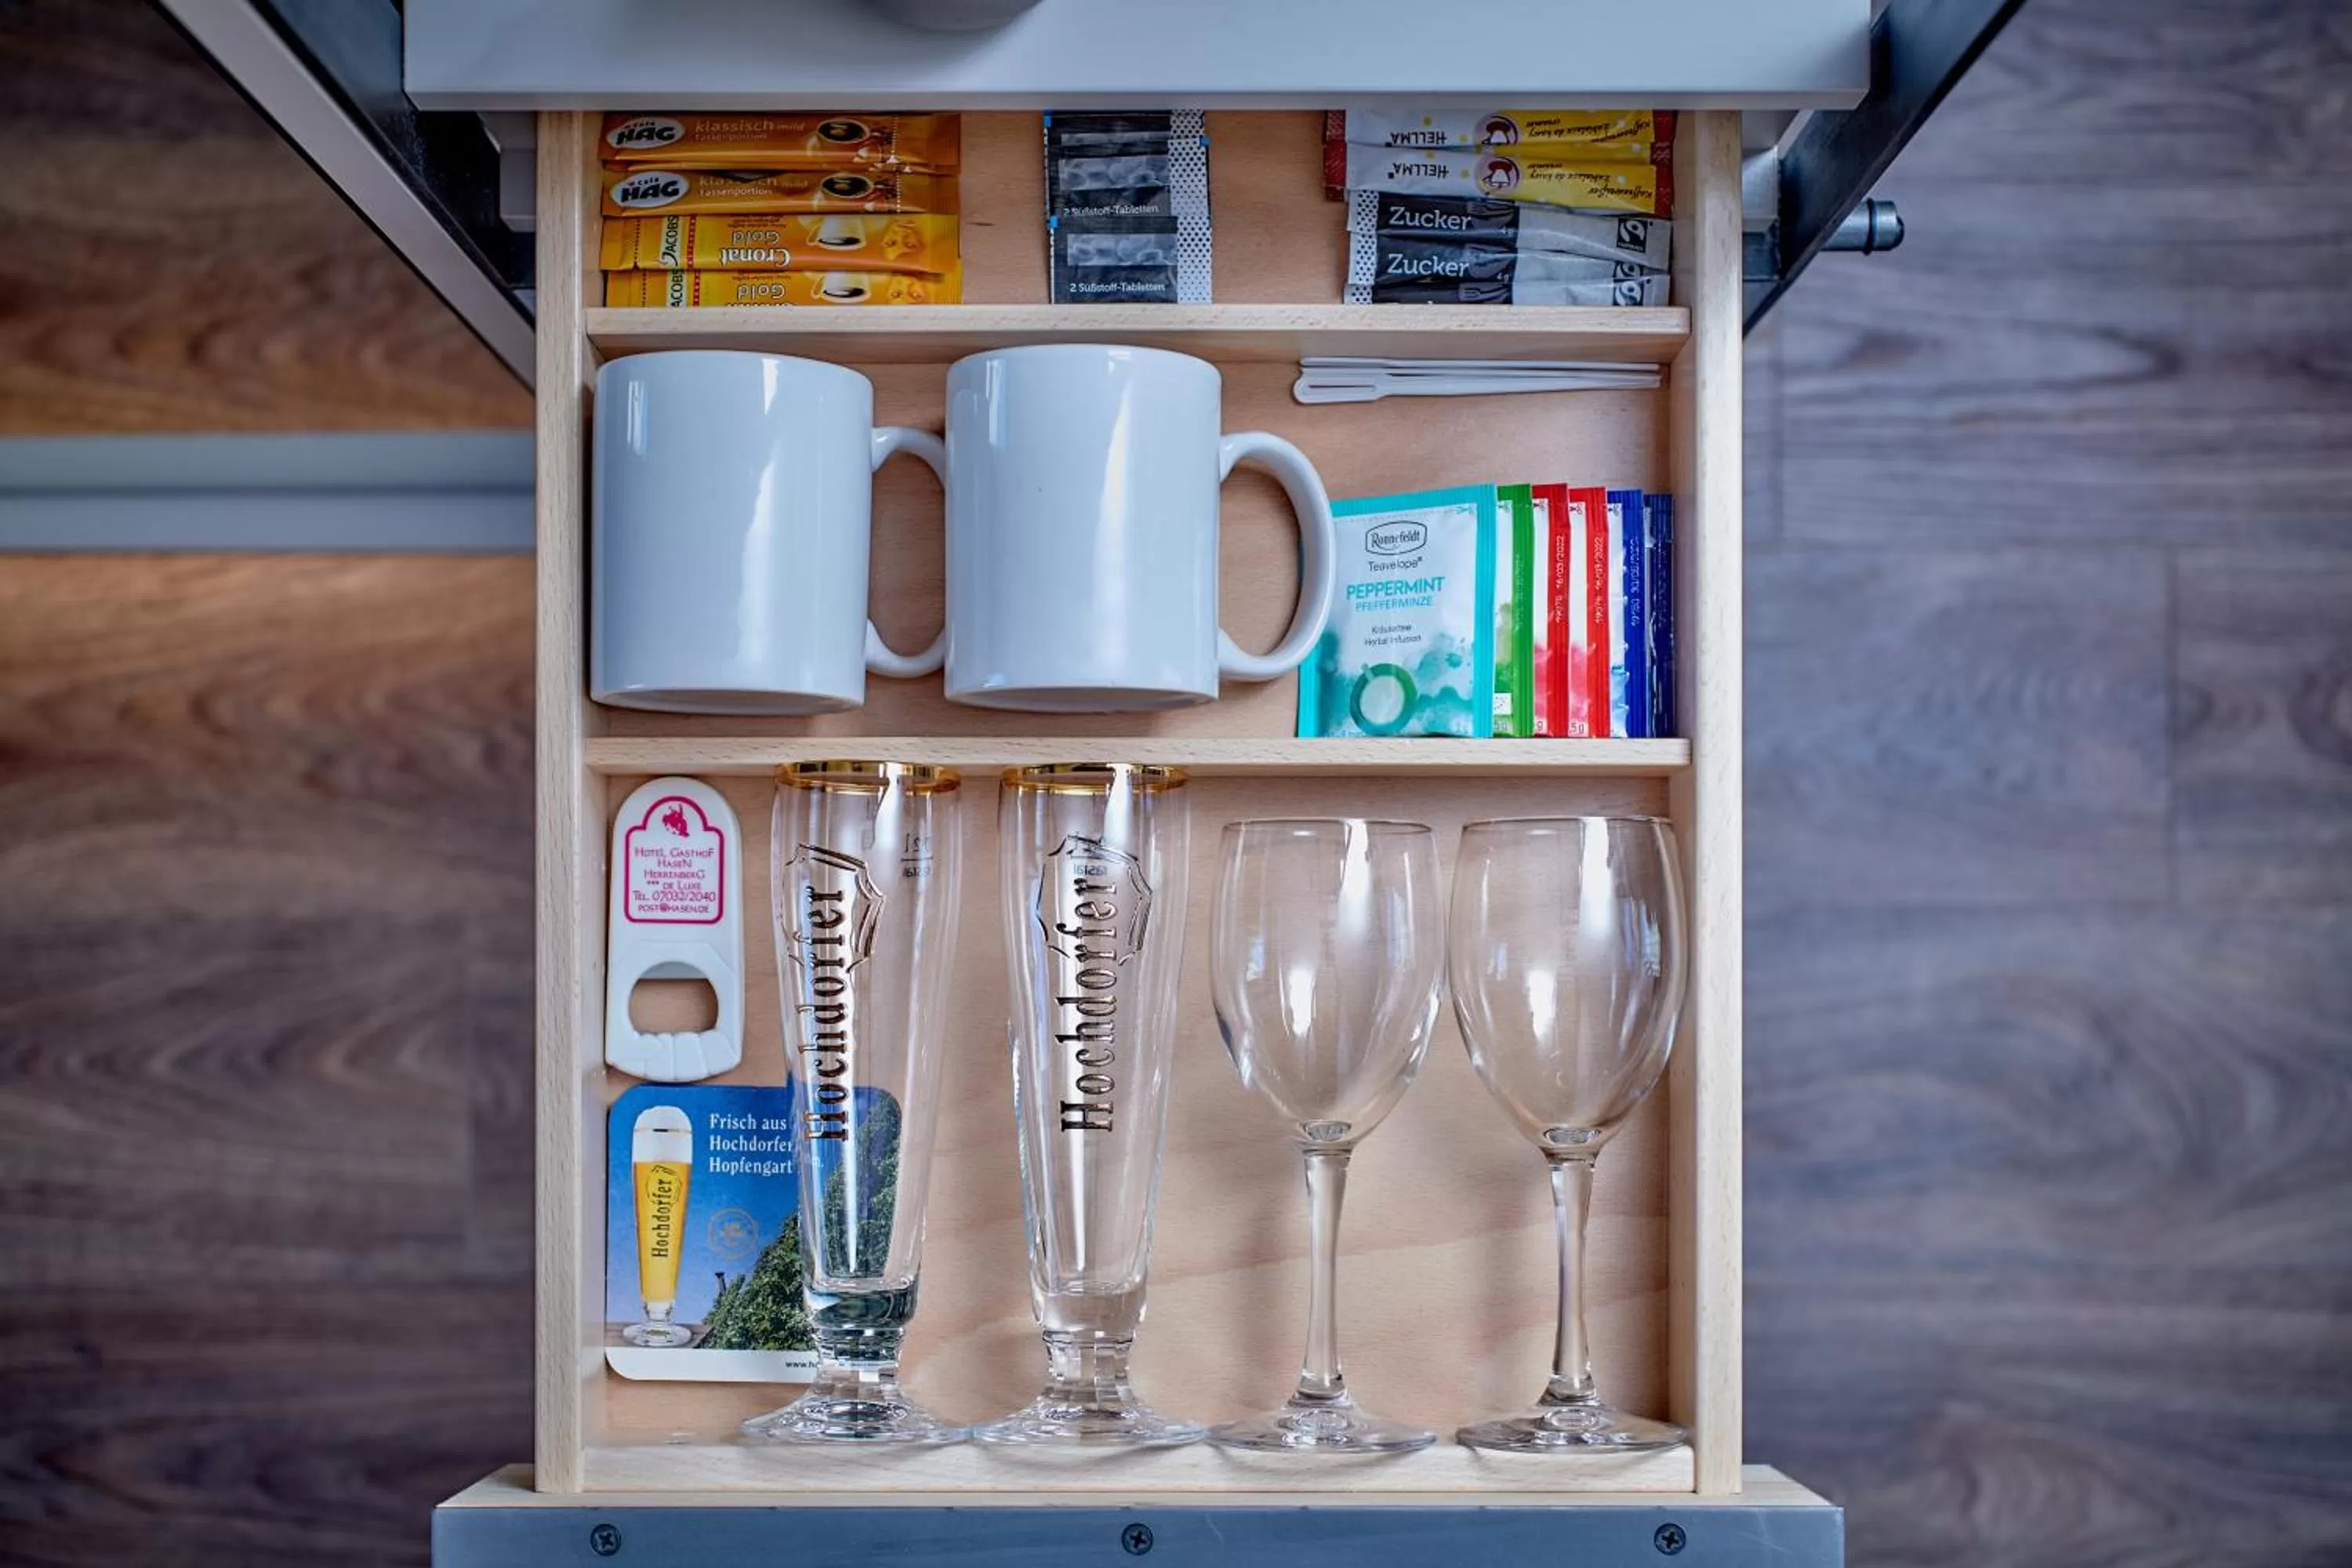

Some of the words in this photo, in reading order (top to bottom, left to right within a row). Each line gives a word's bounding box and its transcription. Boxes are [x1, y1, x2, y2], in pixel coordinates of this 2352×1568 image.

[616, 127, 675, 145] HAG
[1390, 131, 1447, 145] HELLMA
[1393, 162, 1449, 180] HELLMA
[620, 180, 680, 202] HAG
[1389, 206, 1472, 231] Zucker
[661, 216, 679, 267] JACOBS
[731, 231, 779, 245] Gold
[720, 248, 791, 267] Cronat
[1387, 253, 1470, 277] Zucker
[670, 269, 684, 307] ACOBS
[737, 284, 785, 301] Gold
[1070, 283, 1077, 292] 2
[1370, 530, 1421, 550] Ronnefeldt
[1346, 576, 1445, 601] PEPPERMINT
[1355, 596, 1432, 612] PFEFFERMINZE
[652, 890, 716, 902] 07032/2040
[792, 884, 849, 1142] Hochdorfer
[1054, 877, 1118, 1133] Hochdorfer
[710, 1113, 757, 1130] Frisch
[761, 1118, 787, 1130] aus
[652, 1179, 672, 1258] Hochdorfer
